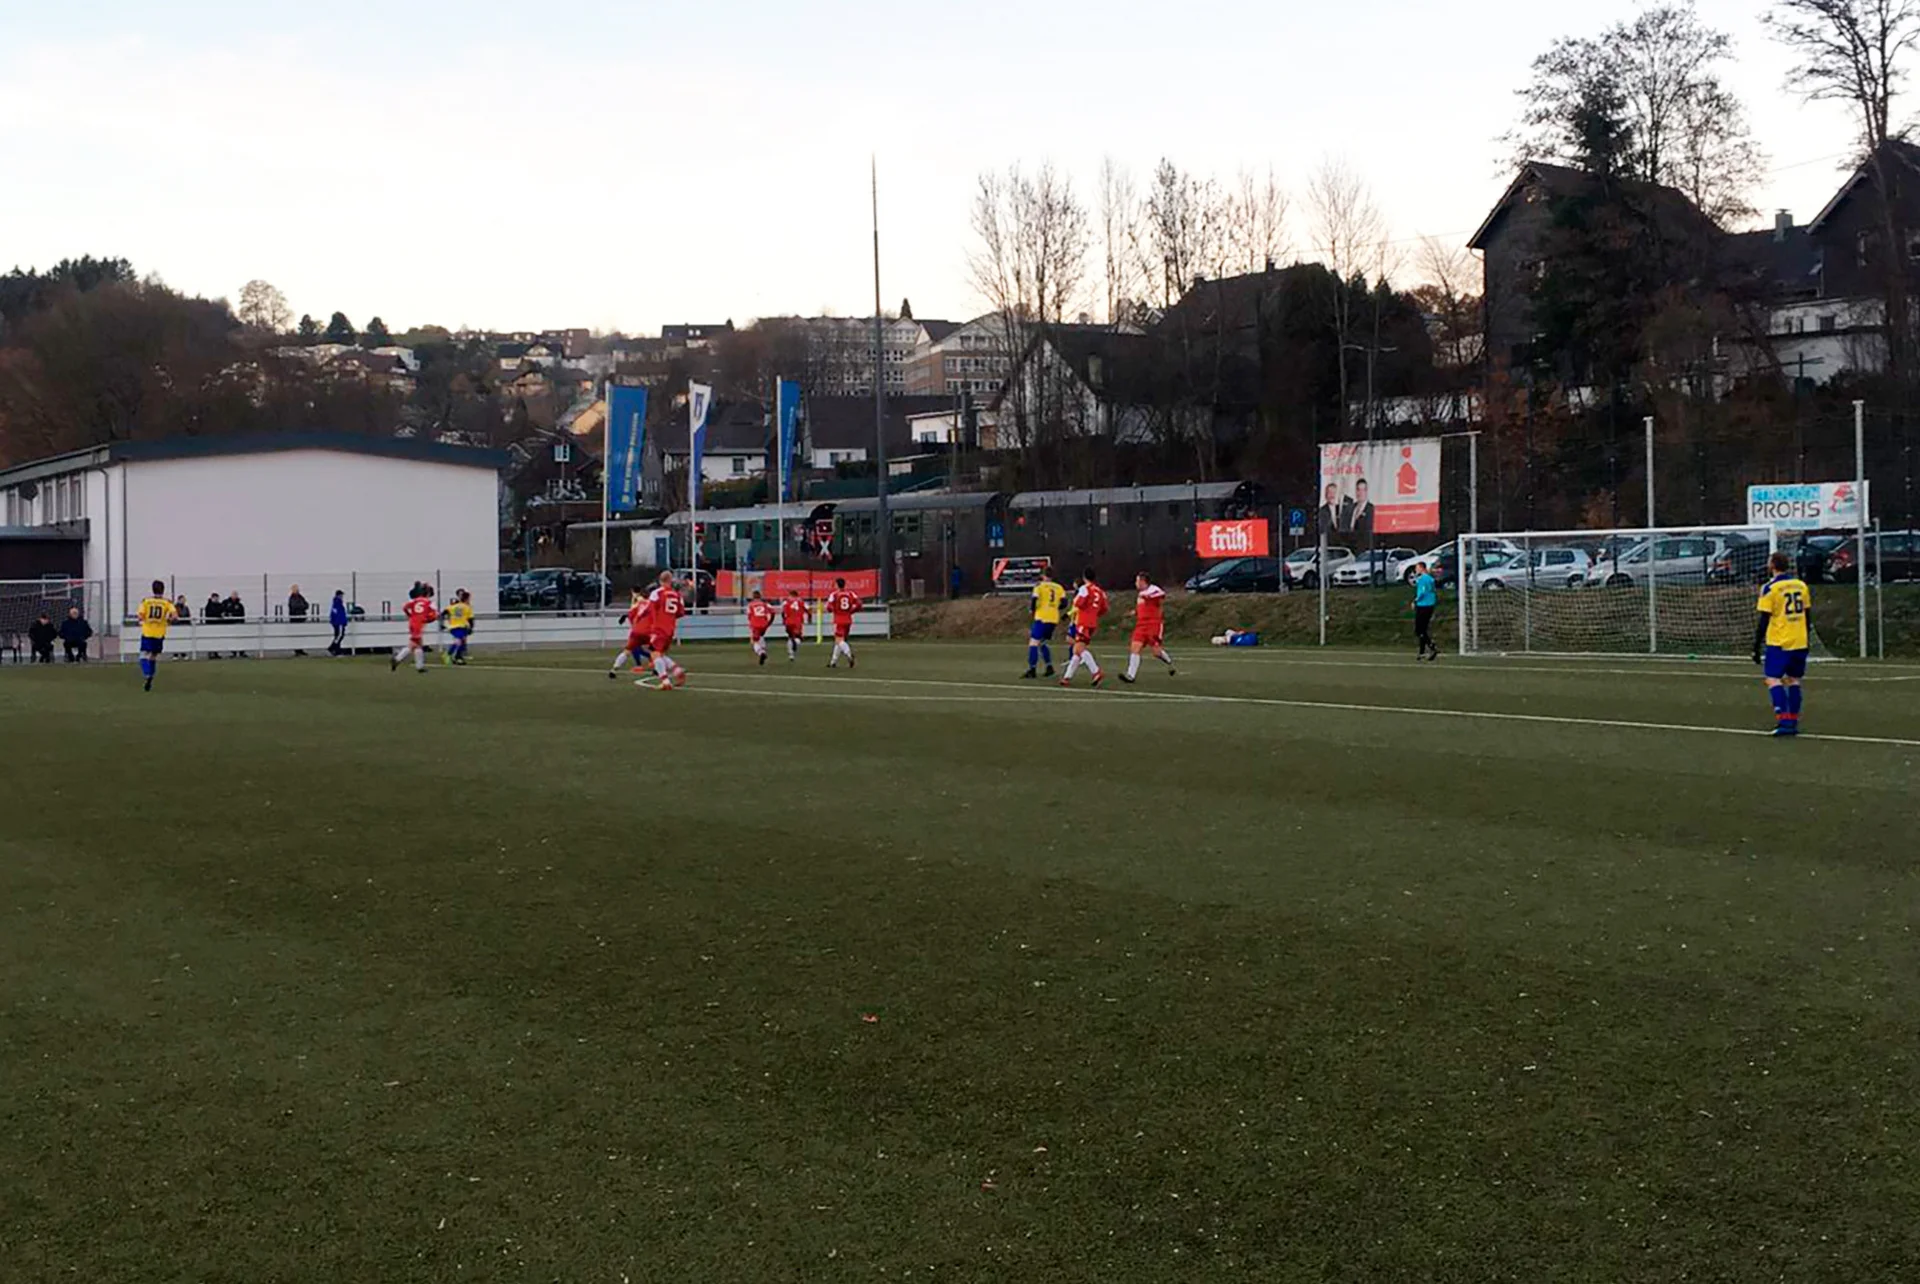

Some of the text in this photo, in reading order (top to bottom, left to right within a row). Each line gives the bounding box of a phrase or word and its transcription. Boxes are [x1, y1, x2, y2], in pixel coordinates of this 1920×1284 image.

[1751, 500, 1821, 518] PROFIS
[790, 601, 799, 611] 4
[840, 598, 850, 610] 8
[1092, 593, 1100, 607] 2
[1784, 592, 1804, 615] 26
[149, 606, 162, 619] 10
[414, 601, 424, 613] 6
